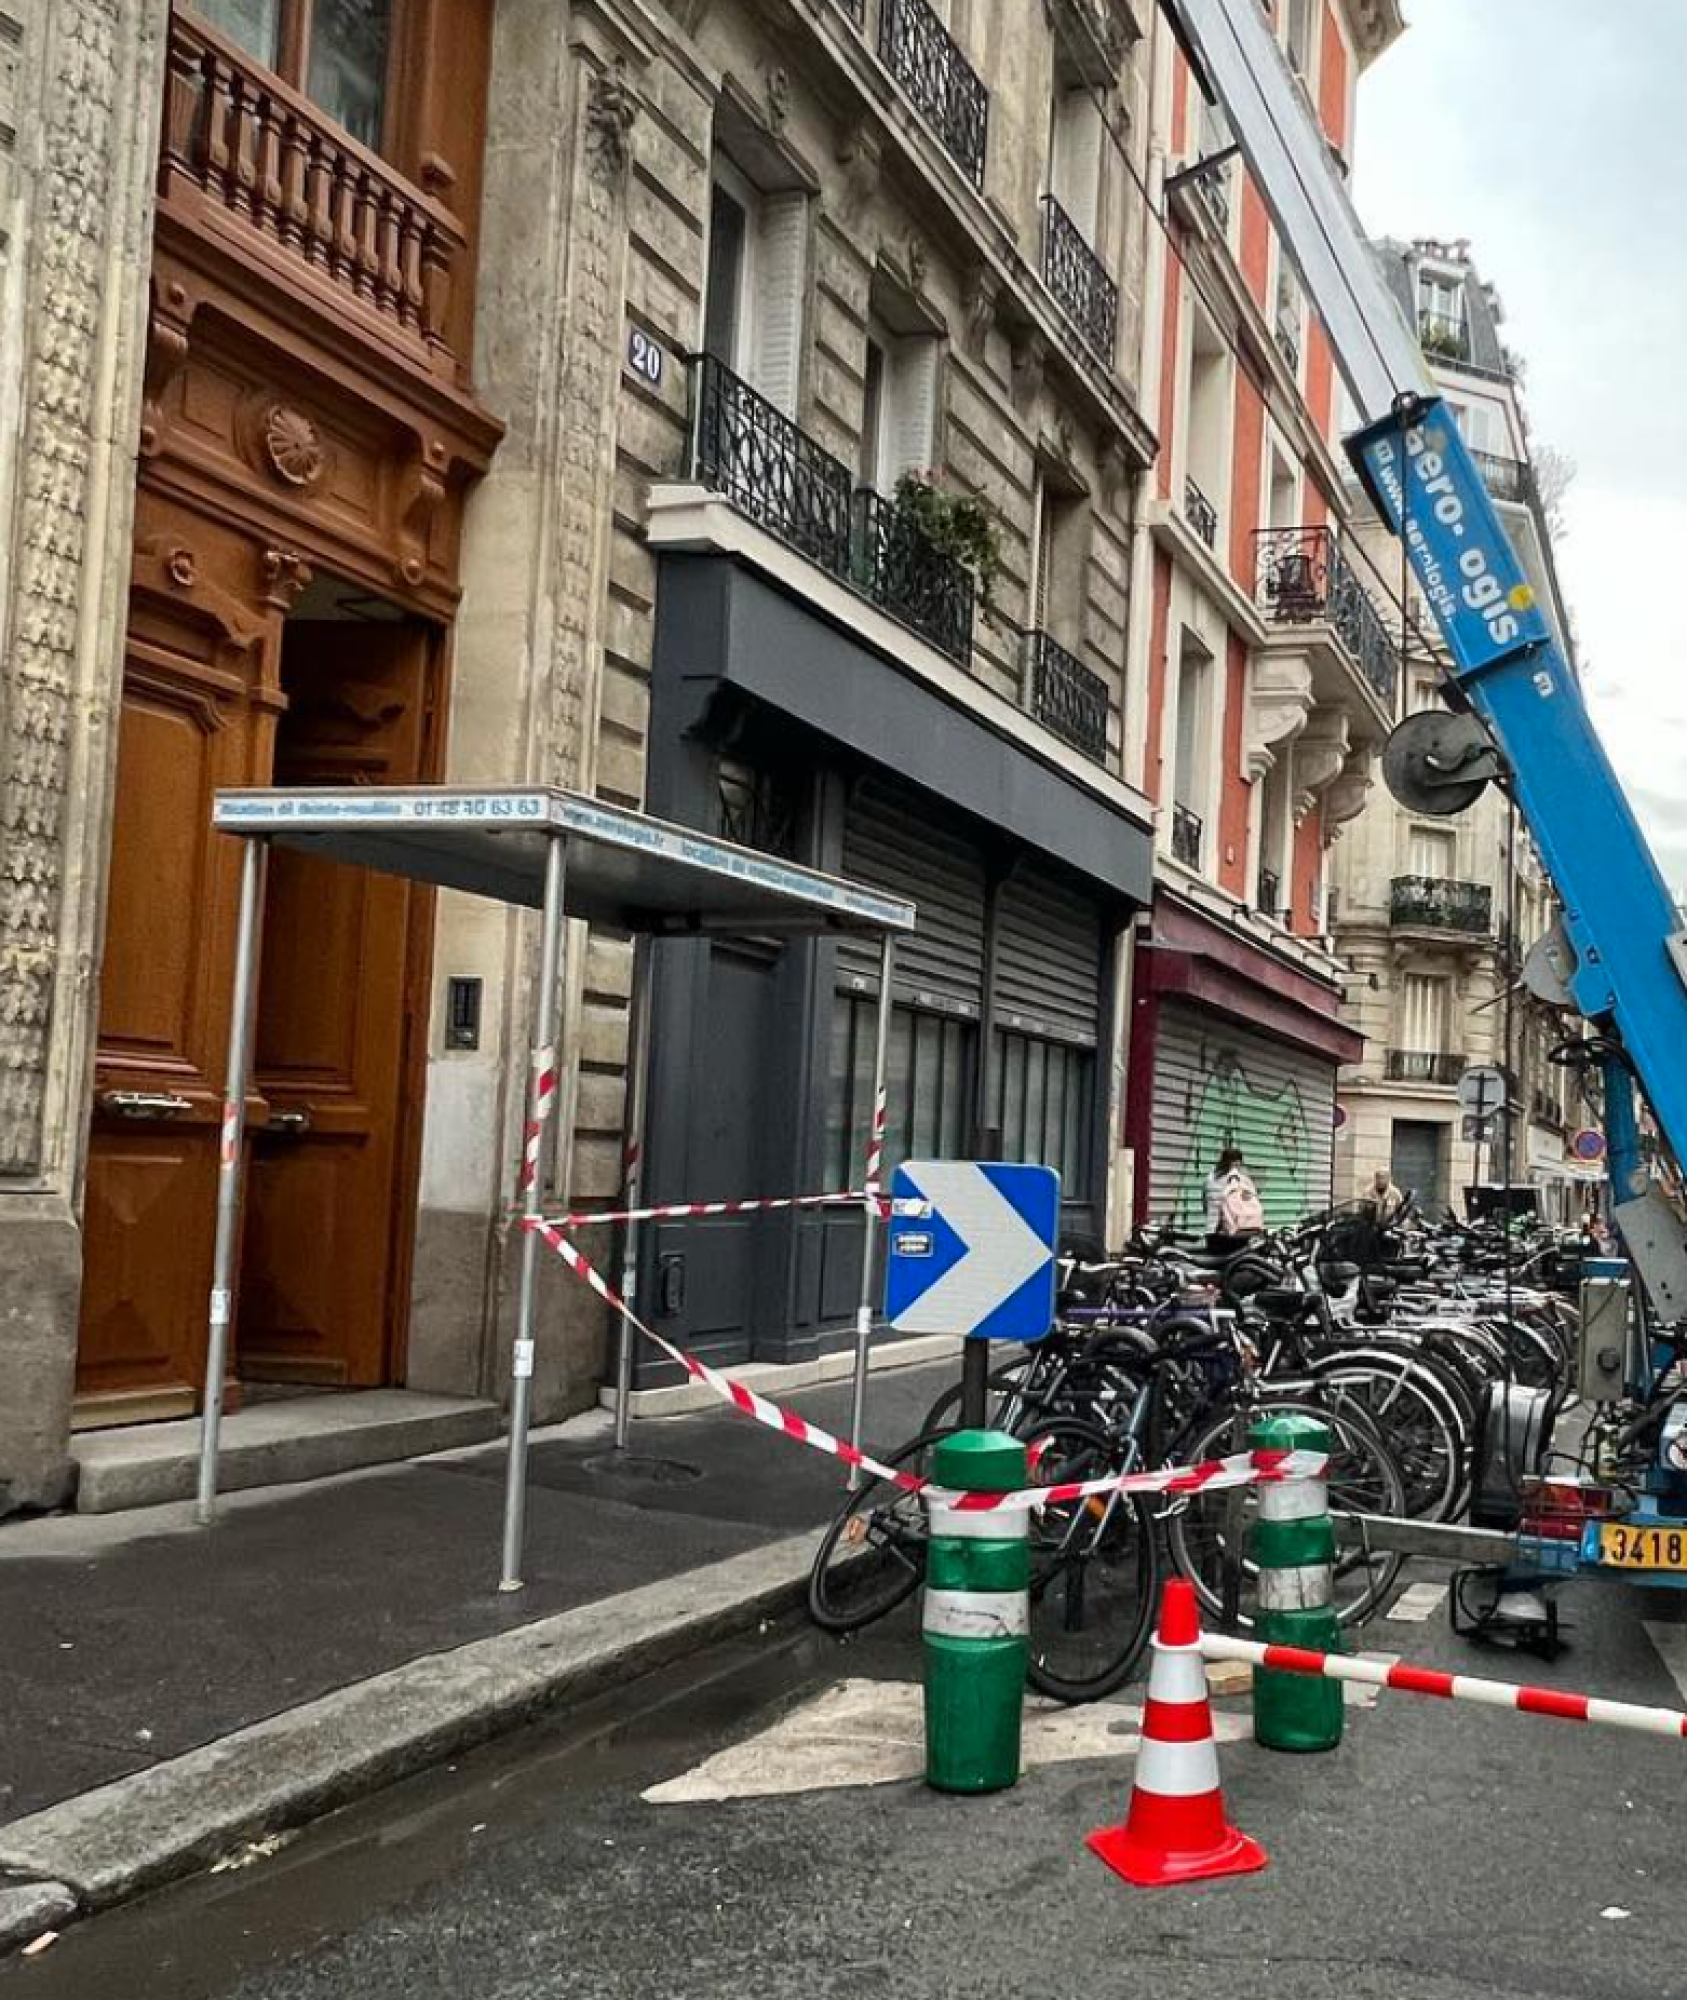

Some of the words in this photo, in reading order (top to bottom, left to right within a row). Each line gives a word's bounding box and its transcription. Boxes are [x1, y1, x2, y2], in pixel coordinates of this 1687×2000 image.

[632, 334, 660, 379] 20
[518, 799, 540, 815] 63
[1611, 1528, 1682, 1565] 3418
